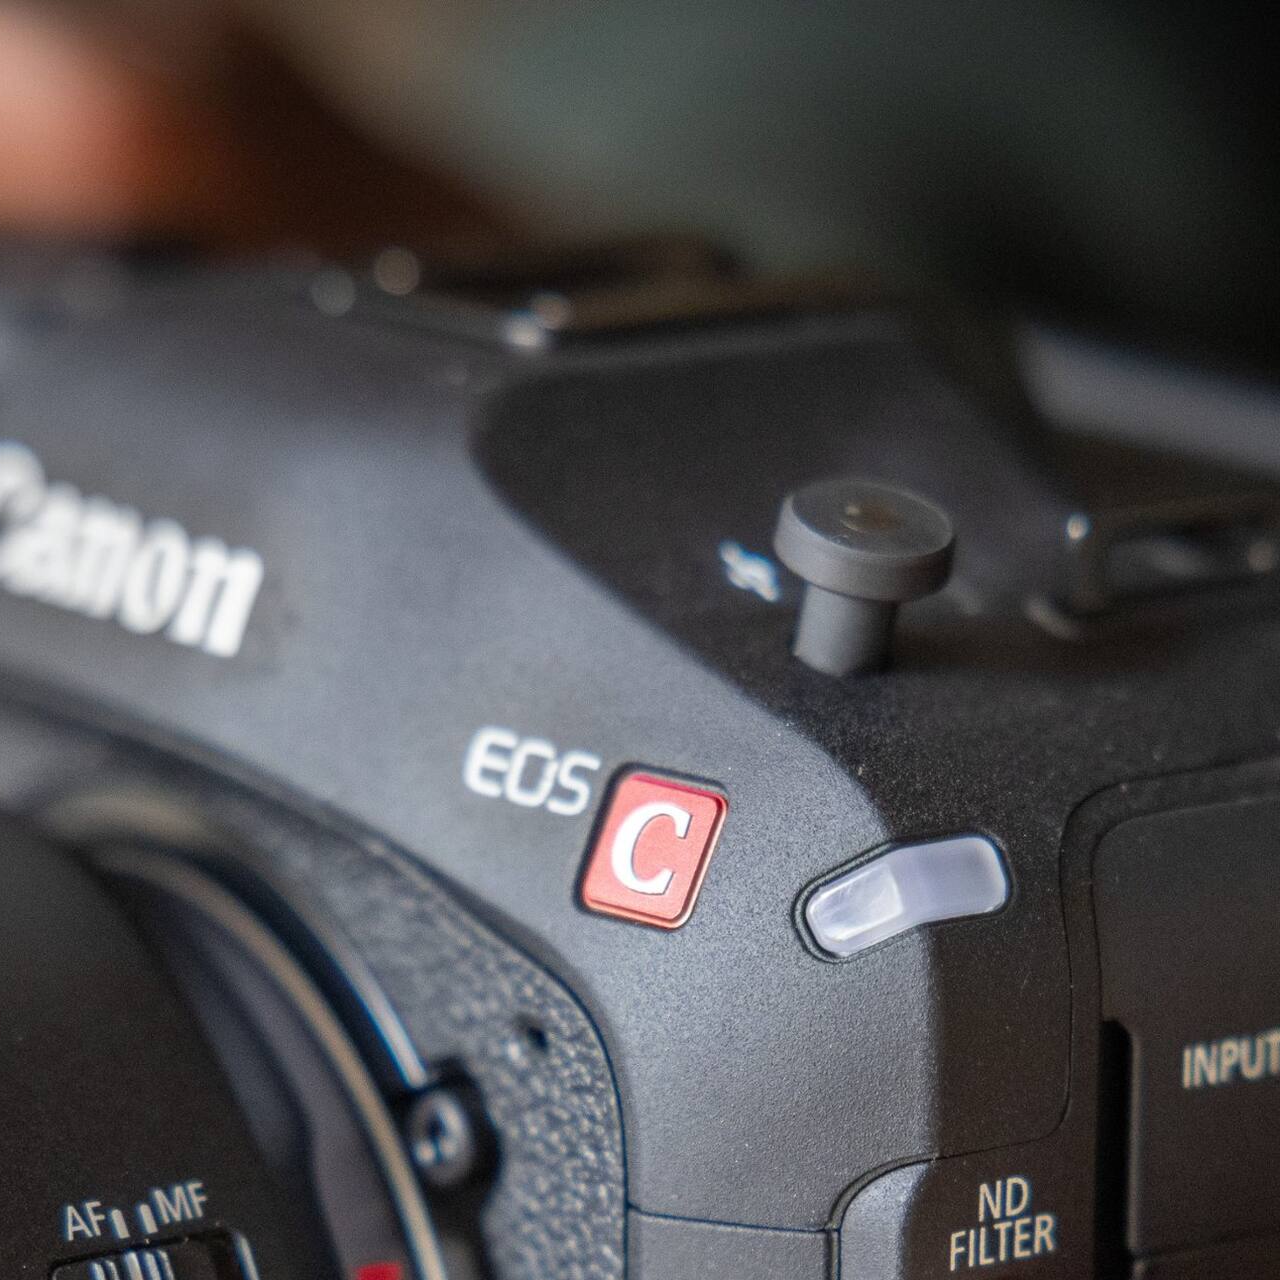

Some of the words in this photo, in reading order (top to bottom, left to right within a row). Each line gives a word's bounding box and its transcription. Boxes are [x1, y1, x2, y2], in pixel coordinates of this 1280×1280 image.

[464, 726, 601, 816] EOS
[611, 801, 692, 895] C
[64, 1200, 107, 1241] AF
[152, 1181, 208, 1225] MF
[978, 1175, 1031, 1222] ND
[949, 1213, 1056, 1272] FILTER
